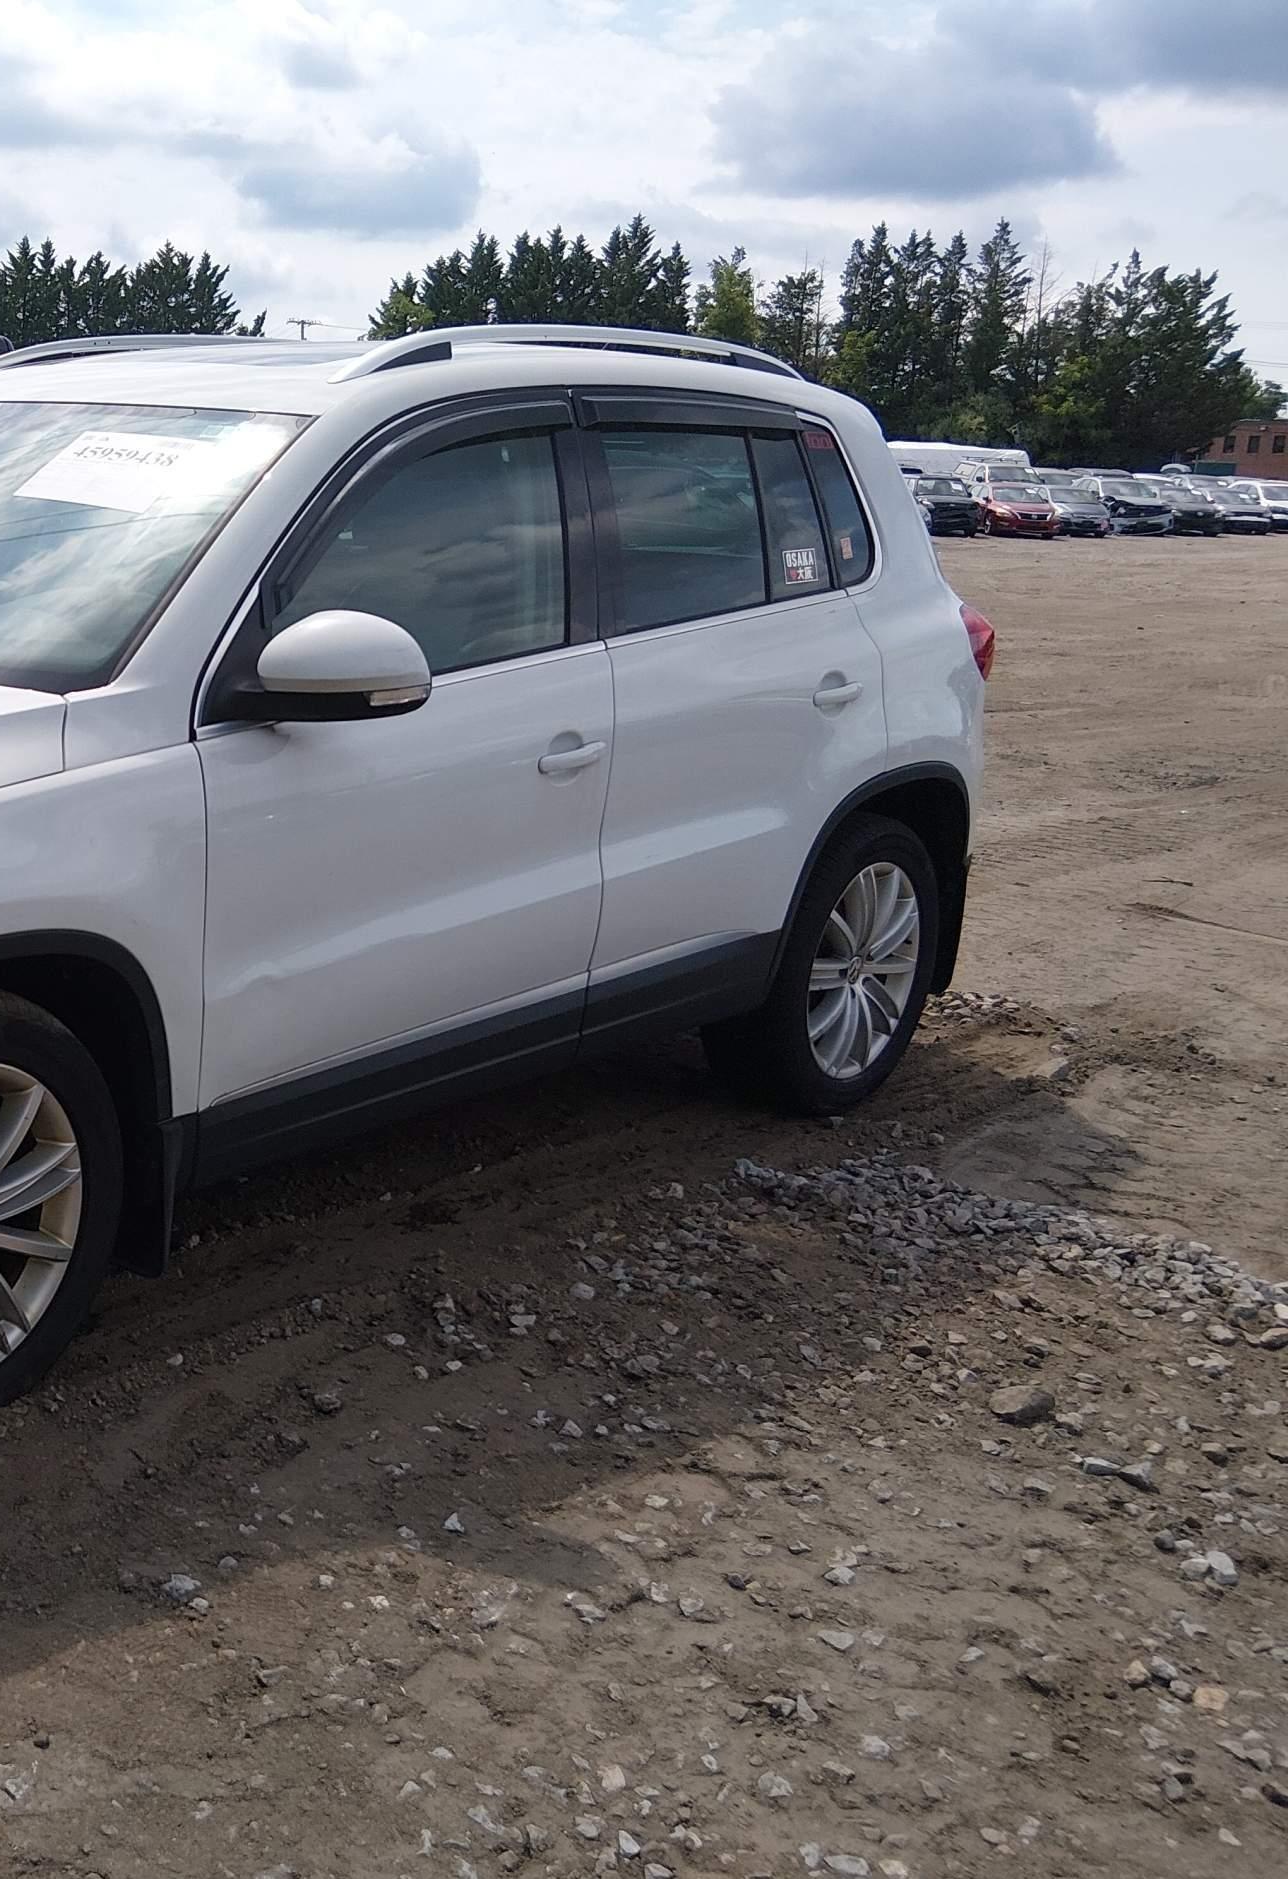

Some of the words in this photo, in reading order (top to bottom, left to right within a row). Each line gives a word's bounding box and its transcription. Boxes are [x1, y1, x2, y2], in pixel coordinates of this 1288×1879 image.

[73, 445, 180, 467] 45959438
[785, 550, 814, 568] OSAKA
[796, 566, 814, 580] 大阪
